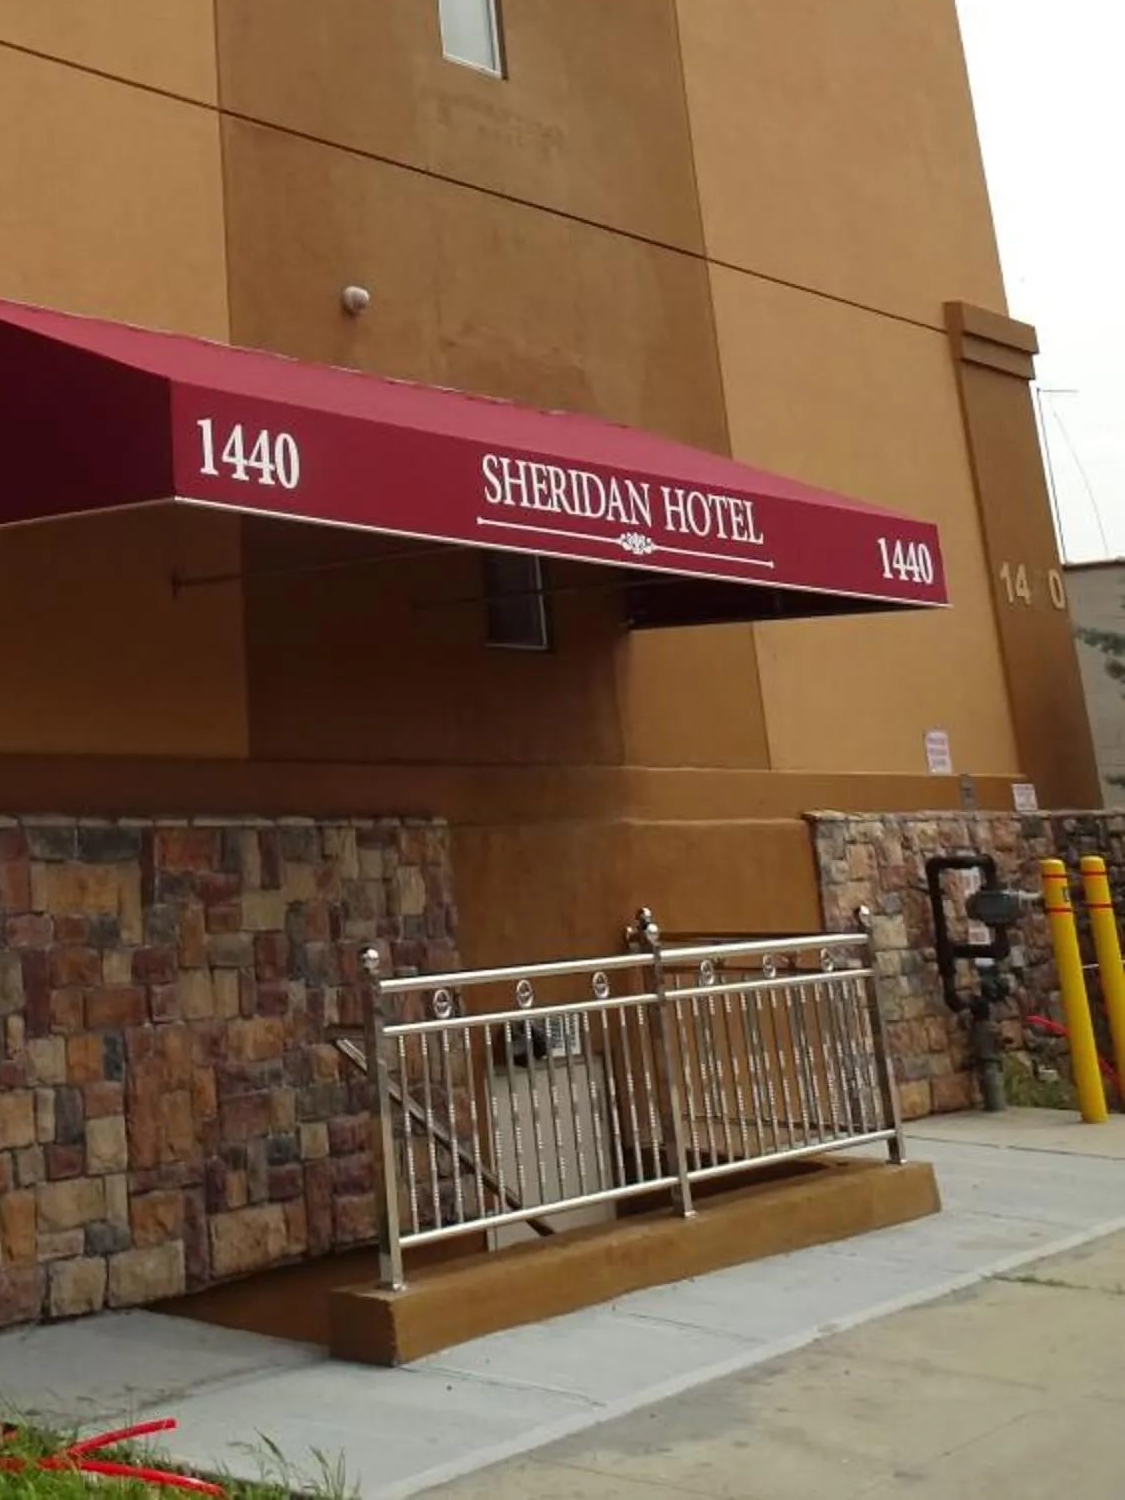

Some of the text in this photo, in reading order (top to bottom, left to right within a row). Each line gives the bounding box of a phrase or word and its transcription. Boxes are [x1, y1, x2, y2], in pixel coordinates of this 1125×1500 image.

[196, 417, 300, 490] 1440
[481, 453, 764, 546] SHERIDAN HOTEL
[876, 536, 934, 585] 1440
